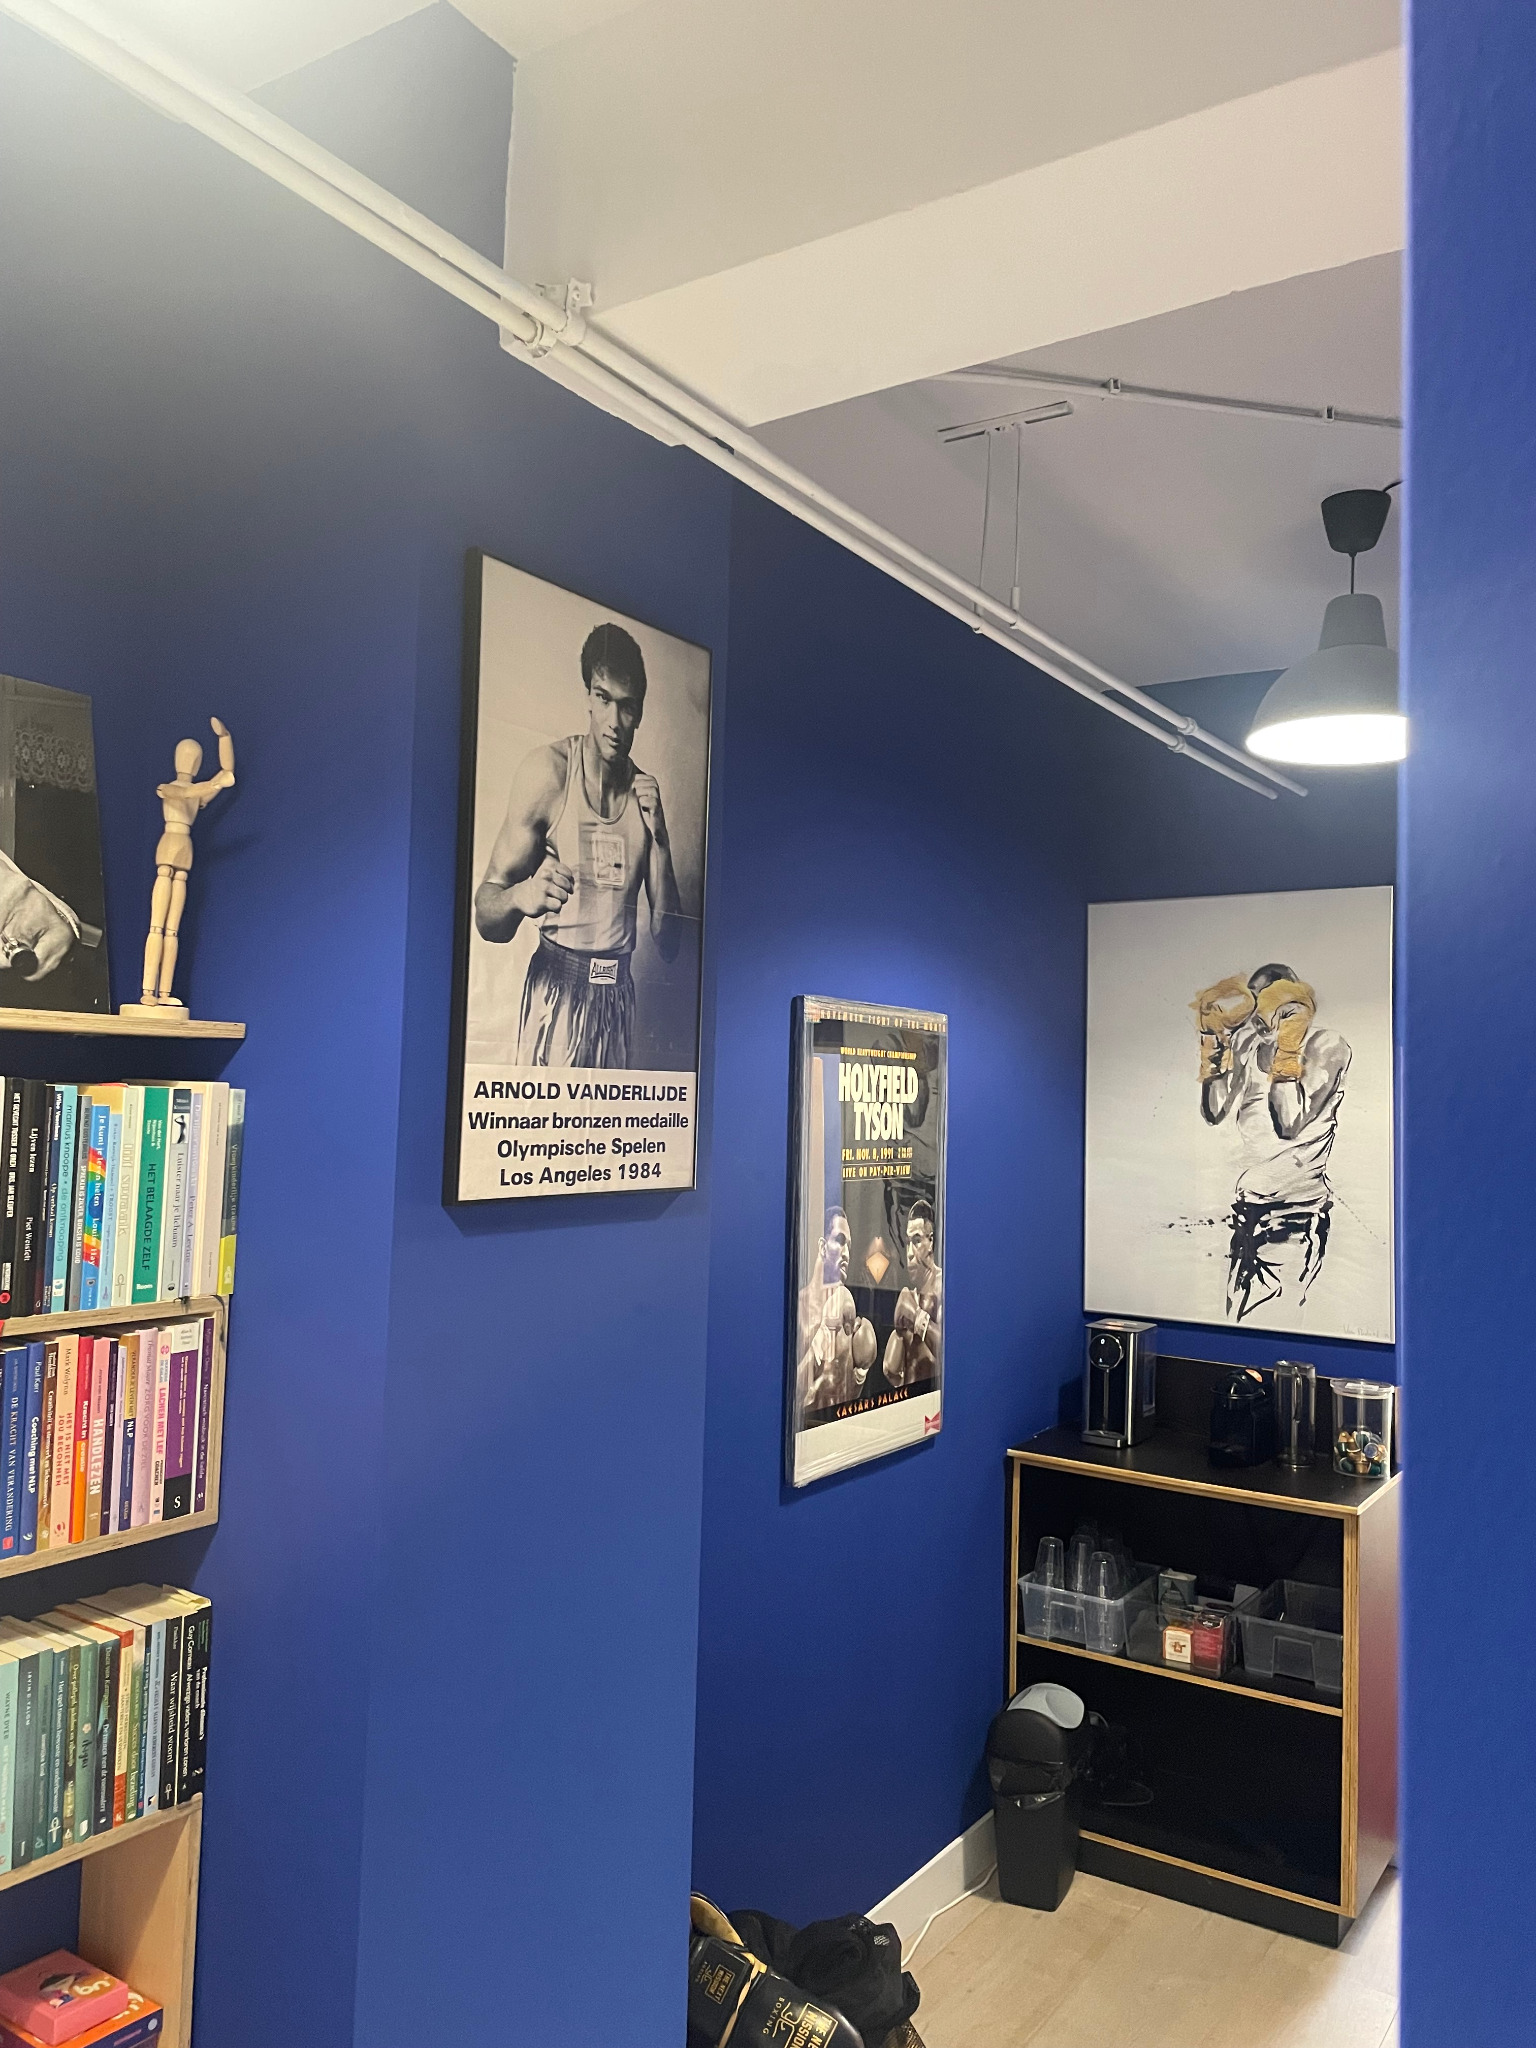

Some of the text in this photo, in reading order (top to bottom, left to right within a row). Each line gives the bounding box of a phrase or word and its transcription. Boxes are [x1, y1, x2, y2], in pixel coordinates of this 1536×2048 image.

[868, 1015, 890, 1027] FIGHT
[894, 1018, 903, 1028] OF
[907, 1020, 919, 1029] THE
[840, 1046, 917, 1061] WORLD HEAVYWEIGHT CHAMPIONSHIP
[474, 1081, 687, 1102] ARNOLD VANDERLIJDE
[838, 1062, 919, 1103] HOLYFIELD
[64, 1104, 73, 1139] marinus
[468, 1112, 688, 1129] Winnaar bronzen medaille
[854, 1102, 904, 1141] TYSON
[61, 1142, 71, 1176] knoope
[93, 1115, 106, 1206] Je kunt je leven helen
[497, 1137, 666, 1161] Olympische Spelen
[856, 1148, 870, 1160] NOV.
[175, 1152, 184, 1183] Luister
[500, 1162, 661, 1186] Los Angeles 1984
[842, 1164, 911, 1178] LIVE ON PAY-PER-VIEW
[61, 1187, 68, 1200] de
[116, 1172, 131, 1237] spraak
[141, 1164, 156, 1271] HET BELAAGDE ZELF
[172, 1204, 181, 1213] je
[87, 1217, 99, 1265] Louise Hay
[34, 1361, 42, 1377] Paul
[62, 1348, 72, 1395] Mark Wolynn
[10, 1396, 18, 1408] DE
[878, 1387, 908, 1406] PALACE
[80, 1400, 88, 1428] Kracht
[155, 1387, 166, 1454] LACHEN MET LEF
[9, 1411, 17, 1445] KRACHT
[65, 1432, 71, 1440] IS
[80, 1429, 86, 1438] in
[7, 1449, 15, 1466] VAN
[26, 1416, 39, 1493] Coaching met NLP
[54, 1435, 64, 1486] BEGONNEN
[87, 1417, 105, 1495] HANDLEZEN
[4, 1469, 15, 1531] VERANDERING
[186, 1625, 194, 1639] Guy
[102, 1723, 109, 1731] De
[166, 1671, 177, 1764] Waar wijsheid woont
[131, 1721, 139, 1749] Succes
[130, 1750, 138, 1769] door
[762, 1997, 785, 2034] BOXING
[814, 2015, 833, 2037] THE
